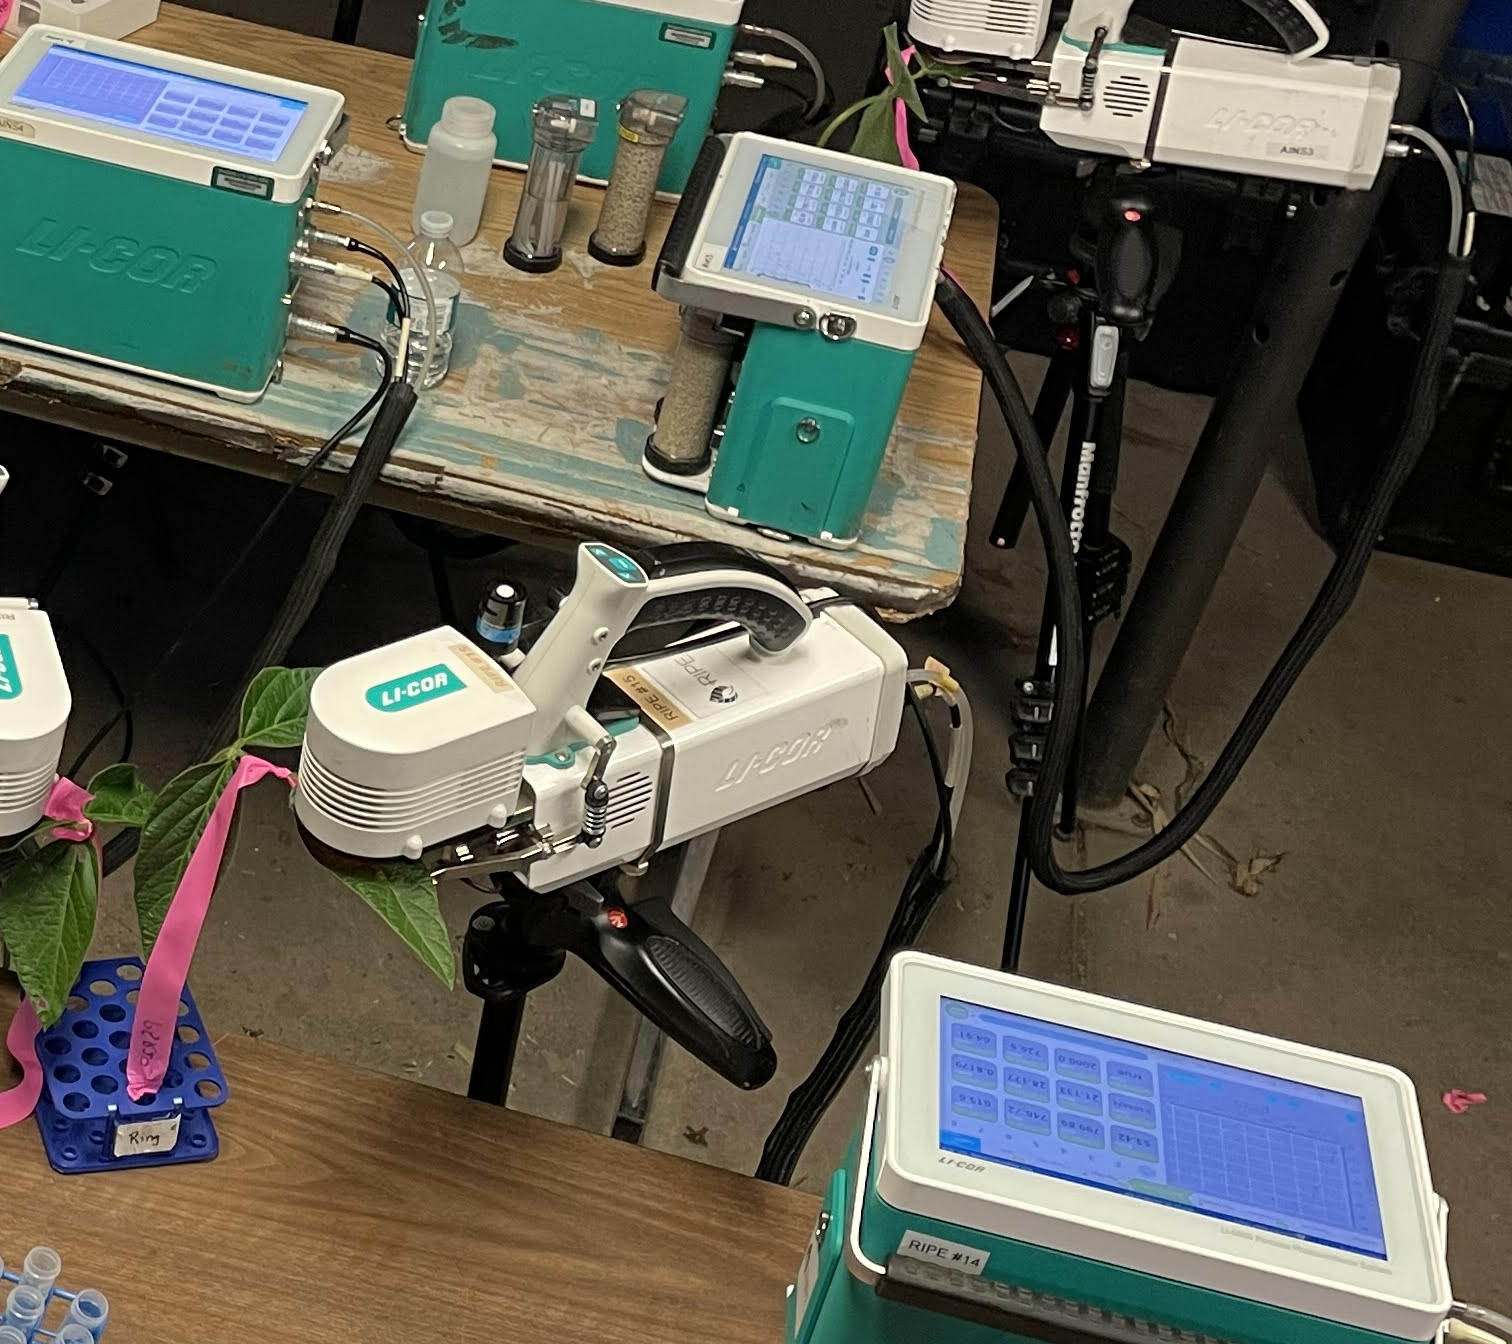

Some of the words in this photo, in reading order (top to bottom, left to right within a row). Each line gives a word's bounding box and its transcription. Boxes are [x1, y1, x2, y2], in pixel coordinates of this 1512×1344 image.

[15, 216, 220, 294] LI-COR
[622, 674, 649, 696] #15
[674, 654, 717, 688] RIPE
[381, 671, 448, 707] LI-COR
[644, 694, 679, 721] RIPE
[714, 725, 833, 793] LI-COR
[128, 1133, 161, 1147] Ring
[908, 1240, 949, 1259] RIPE
[951, 1252, 981, 1267] #14
